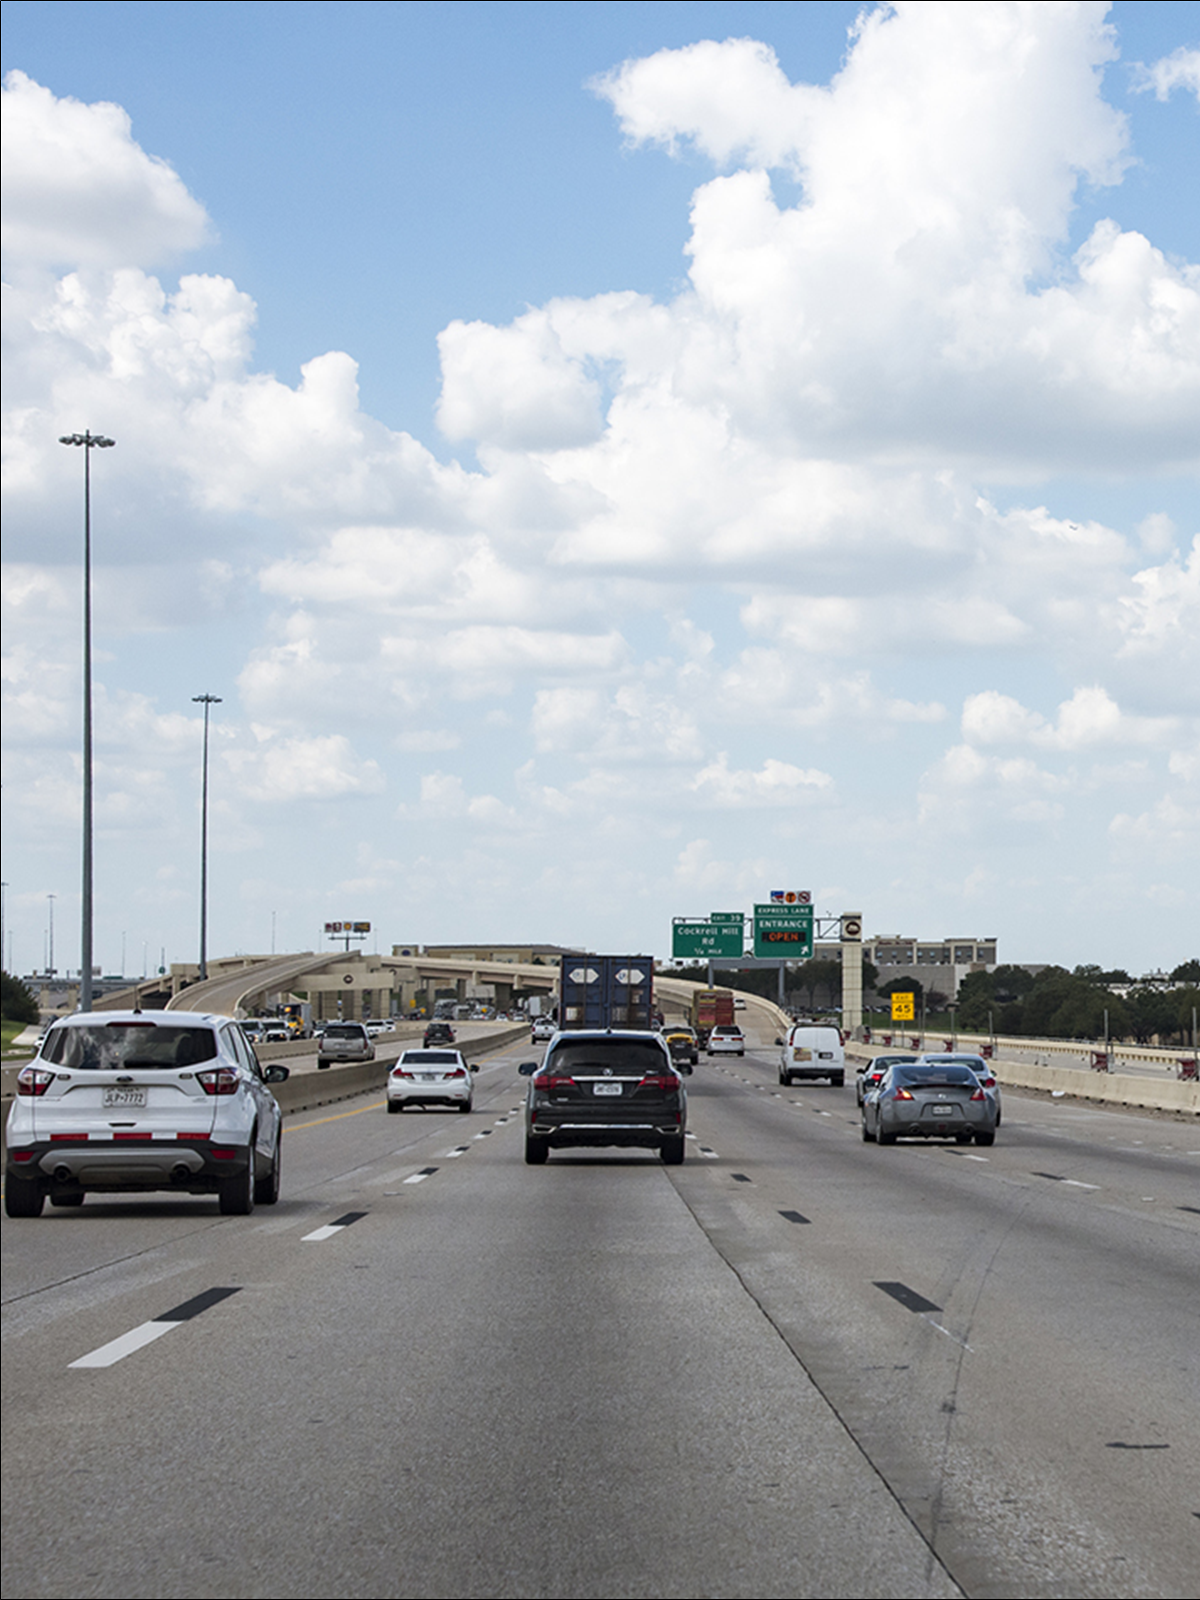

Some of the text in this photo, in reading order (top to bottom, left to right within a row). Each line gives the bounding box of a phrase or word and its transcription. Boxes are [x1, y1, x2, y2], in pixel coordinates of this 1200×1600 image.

[759, 920, 808, 928] ENTRANCE
[677, 927, 738, 935] Cockrell Hill
[768, 932, 799, 941] OPEN
[702, 937, 715, 945] Rd
[895, 1004, 911, 1013] 45
